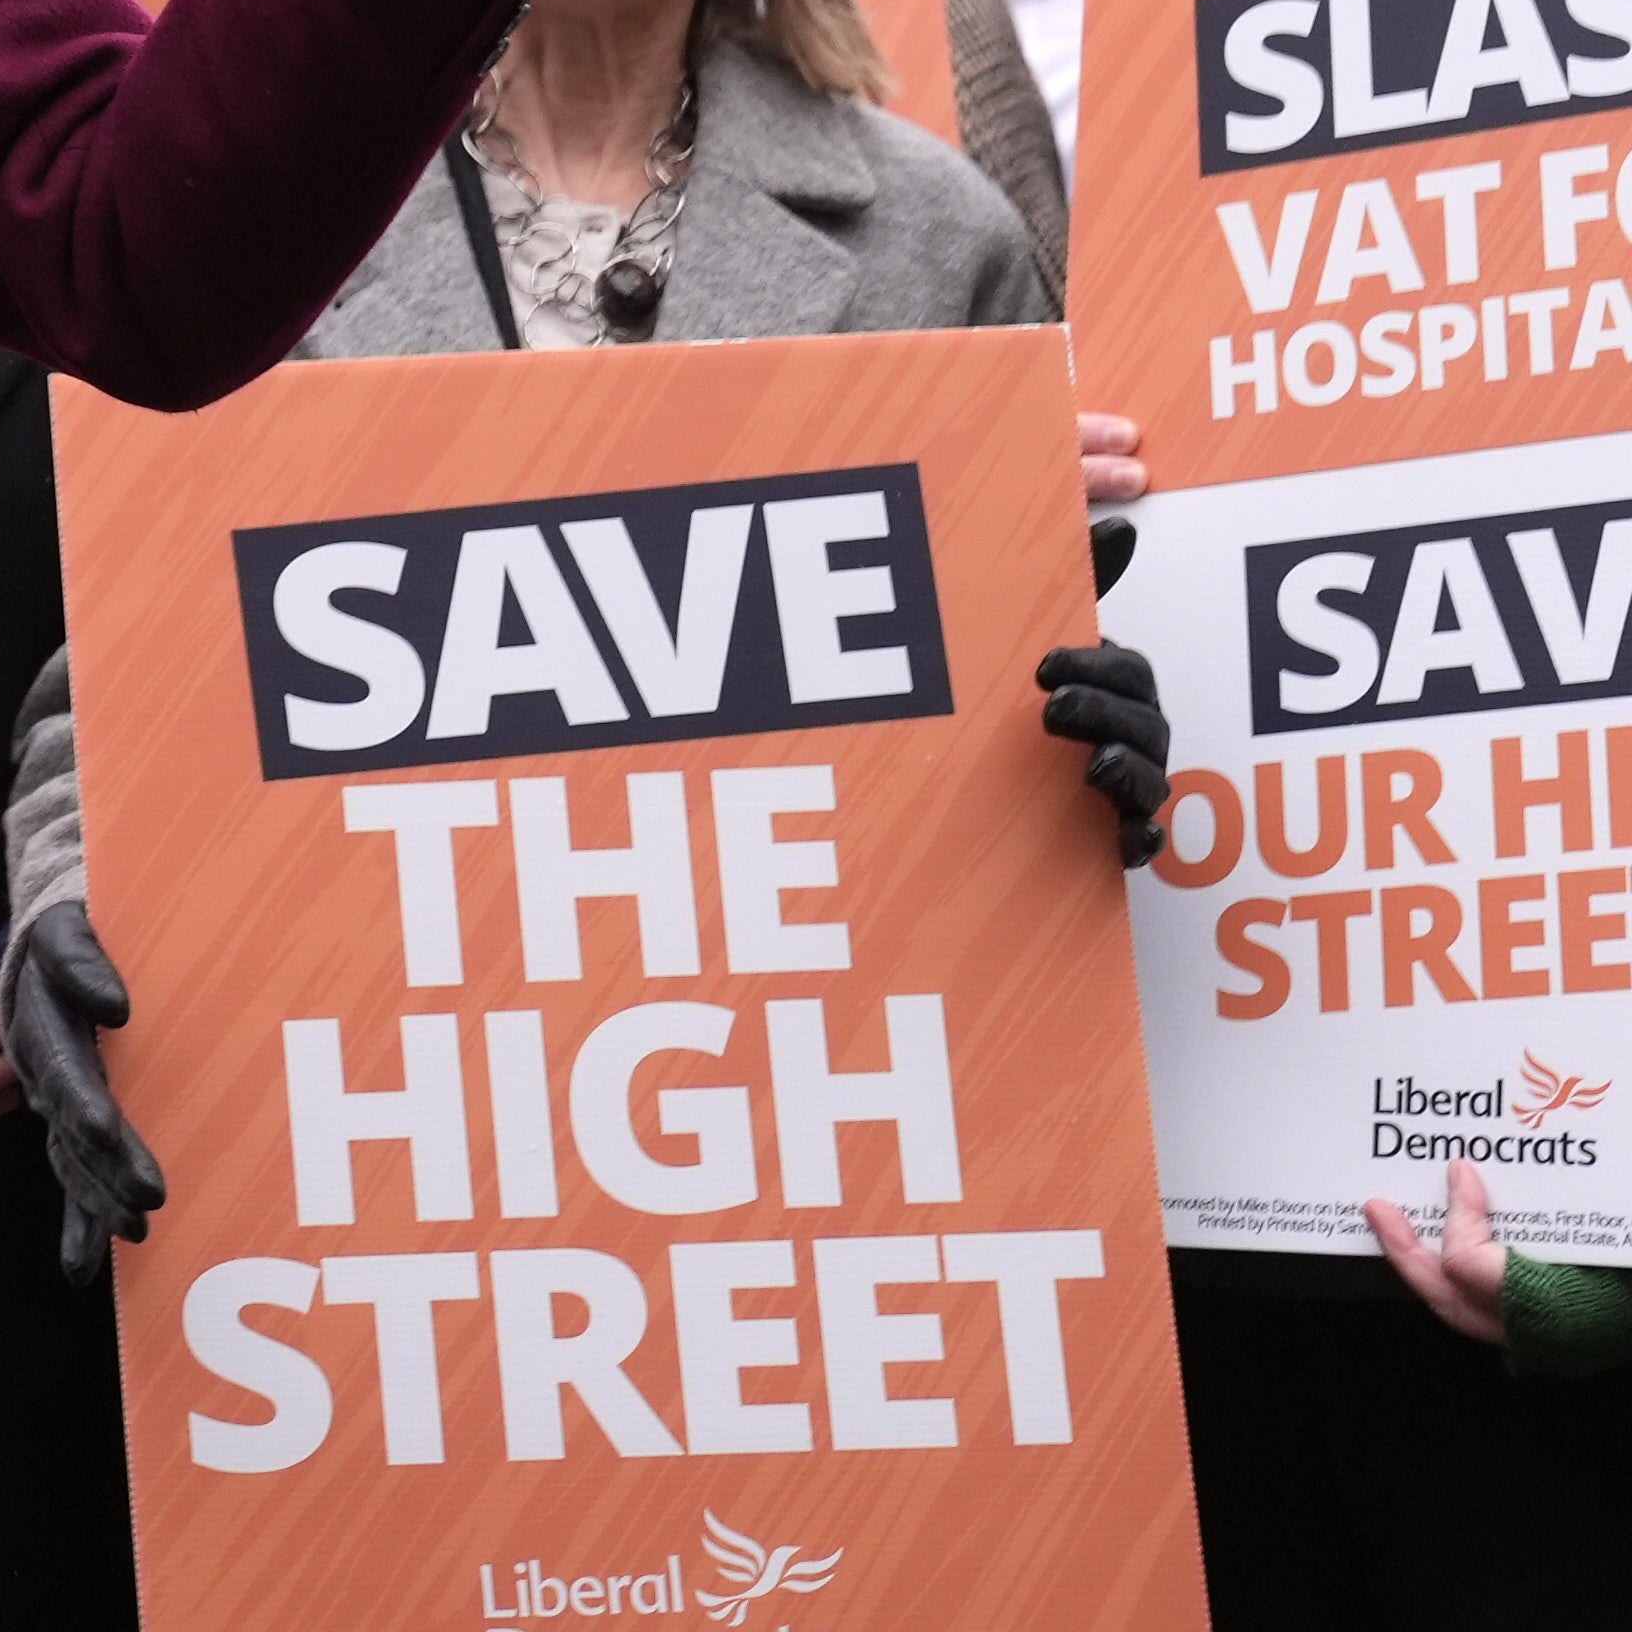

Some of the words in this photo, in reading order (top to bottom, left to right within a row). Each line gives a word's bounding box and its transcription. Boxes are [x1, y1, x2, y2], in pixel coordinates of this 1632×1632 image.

[1216, 160, 1502, 314] VAT
[1539, 143, 1632, 271] F
[272, 490, 913, 749] SAVE
[341, 765, 852, 987] THE
[1149, 747, 1456, 888] OUR
[1216, 867, 1632, 1021] STREE
[282, 993, 963, 1228] HIGH
[1372, 1121, 1598, 1166] Democrats
[1374, 1076, 1504, 1118] Liberal
[182, 1229, 1106, 1475] STREET
[480, 1554, 685, 1619] Liberal
